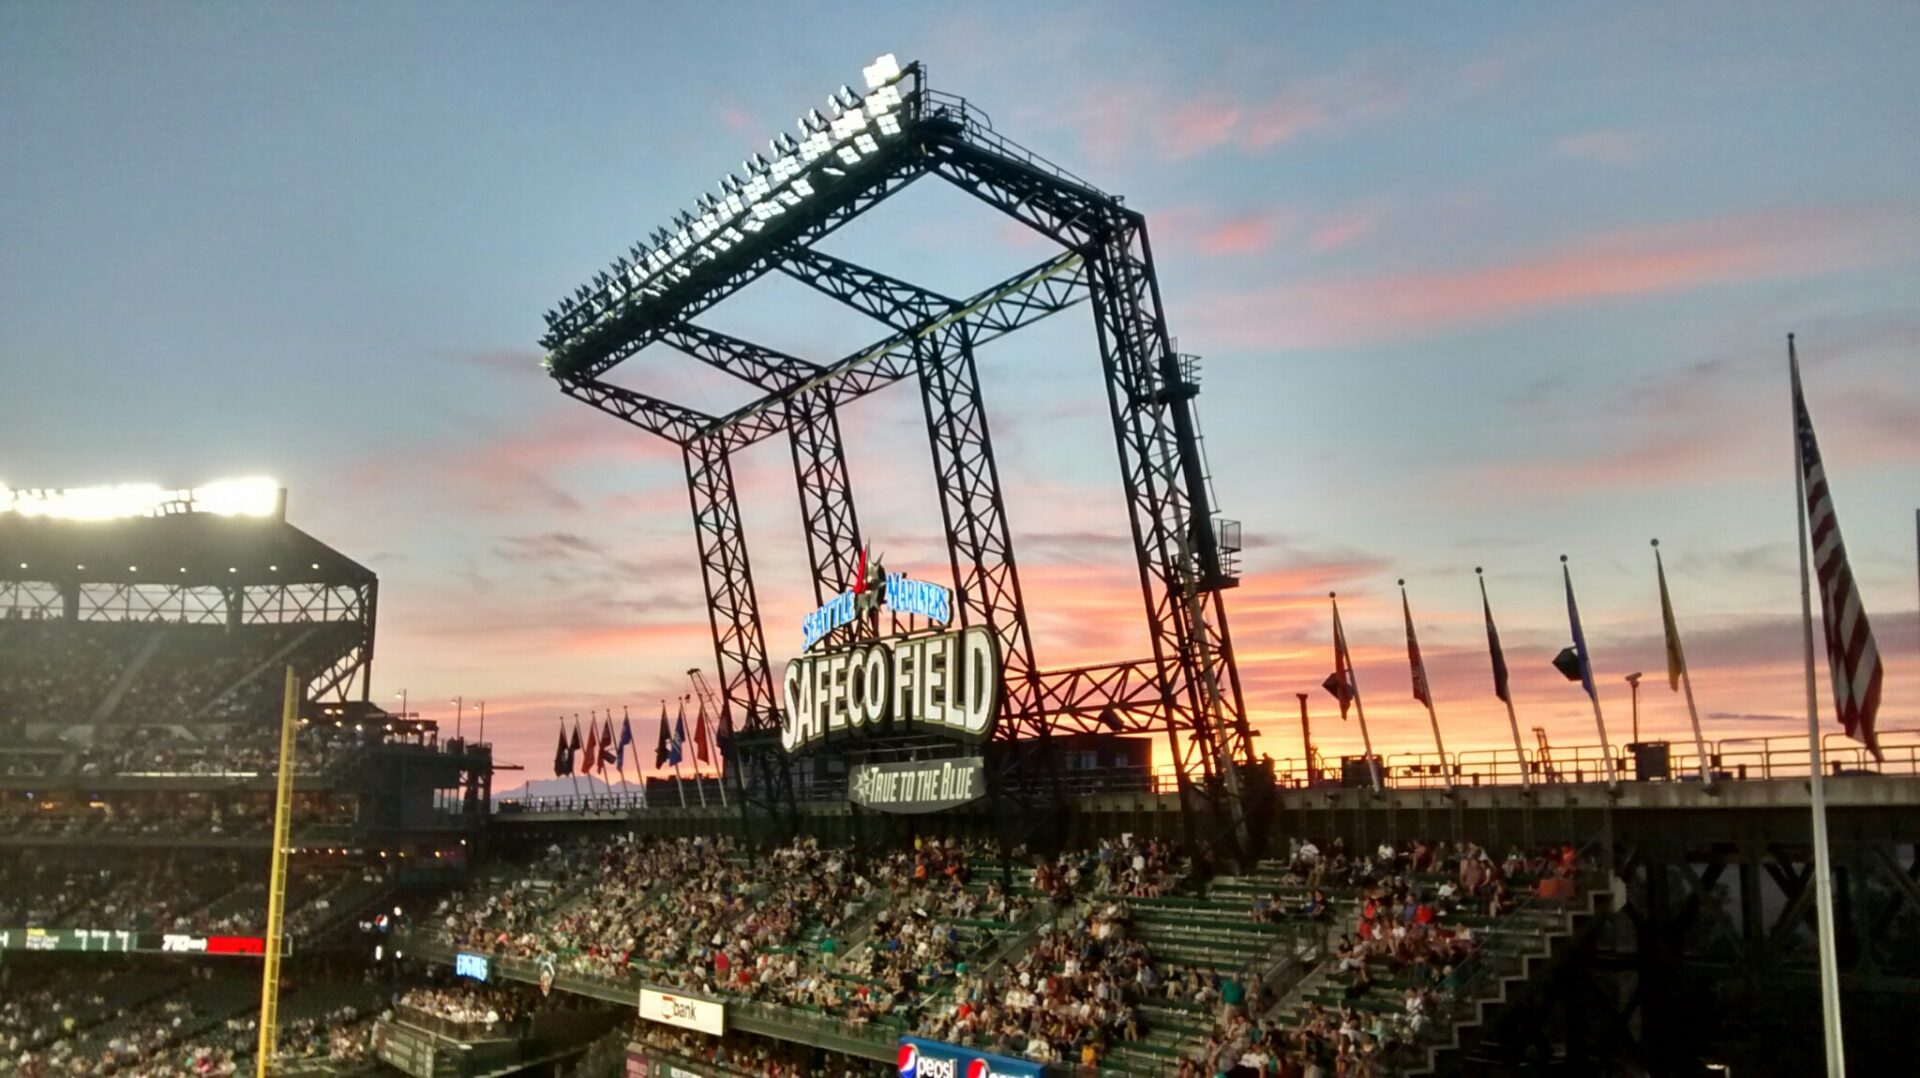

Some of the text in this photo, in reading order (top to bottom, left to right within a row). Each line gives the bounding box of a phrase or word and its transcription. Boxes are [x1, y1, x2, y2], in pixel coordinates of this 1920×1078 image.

[802, 590, 856, 651] SEATTLE
[782, 625, 998, 752] SAFECO FIELD
[869, 762, 975, 802] TRUE TO THE BLUE
[673, 1001, 697, 1020] bank
[916, 1056, 956, 1078] pepsi
